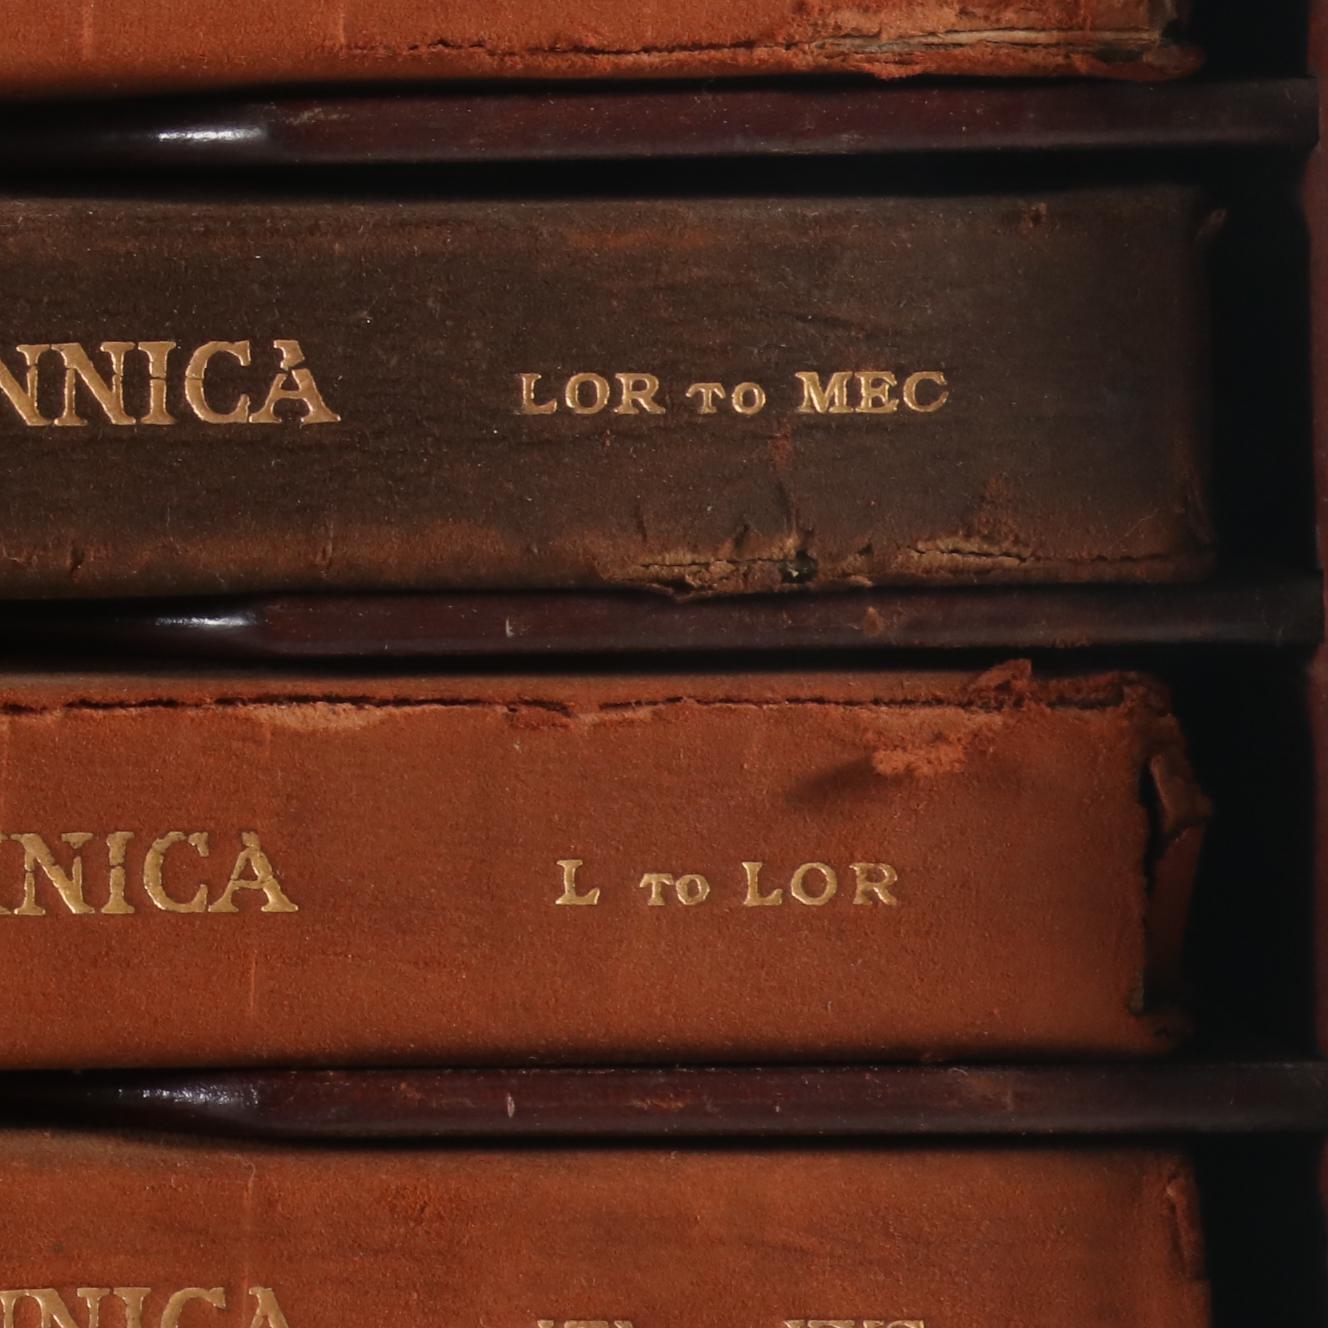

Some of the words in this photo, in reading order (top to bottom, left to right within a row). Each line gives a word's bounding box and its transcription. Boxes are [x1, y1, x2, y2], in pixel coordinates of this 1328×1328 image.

[513, 371, 668, 417] LOR
[794, 370, 951, 416] MEC
[554, 858, 601, 907] L
[742, 860, 900, 908] LOR
